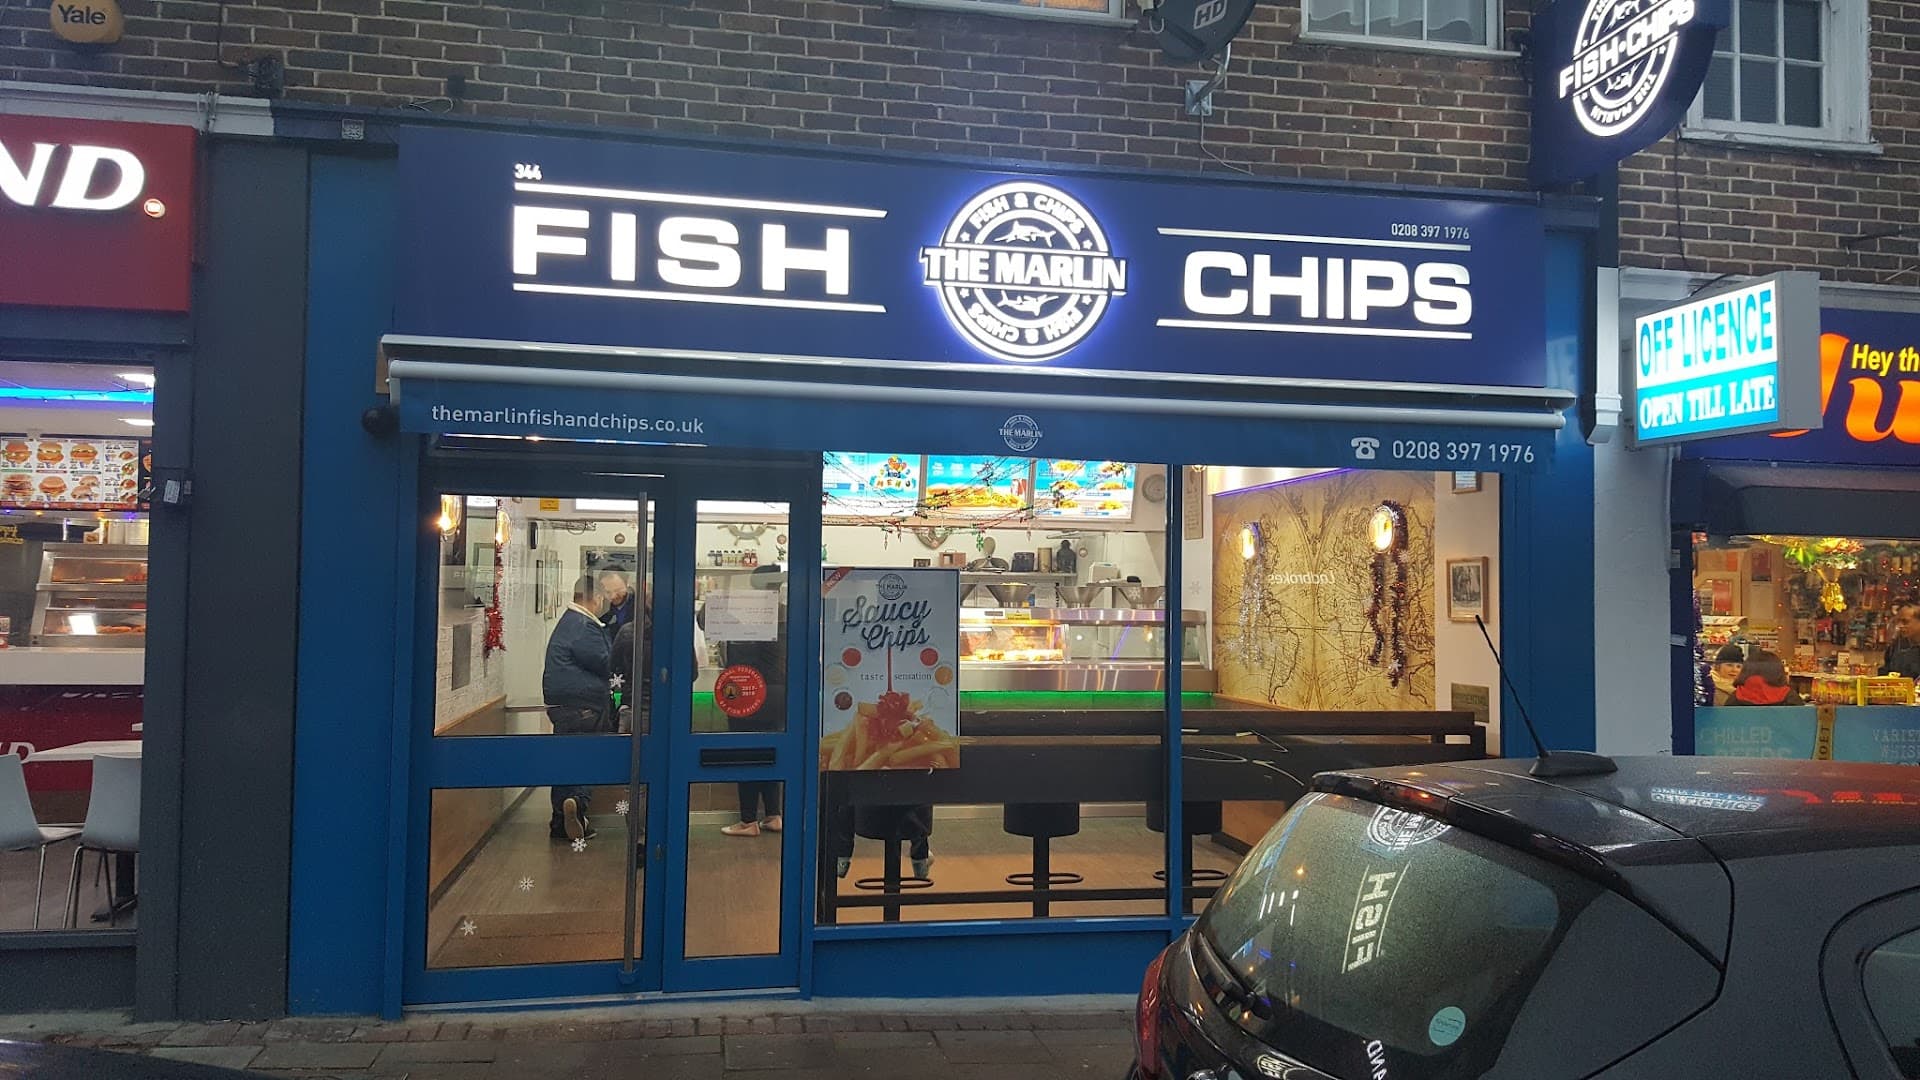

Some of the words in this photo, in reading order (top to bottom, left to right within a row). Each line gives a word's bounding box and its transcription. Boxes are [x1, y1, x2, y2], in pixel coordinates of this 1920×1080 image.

[58, 4, 106, 25] Yale
[515, 163, 542, 180] 344
[968, 194, 1011, 230] FISH
[1033, 194, 1085, 235] CHIPS
[1391, 223, 1418, 237] 0208
[1420, 224, 1441, 238] 397
[1443, 226, 1470, 240] 1976
[513, 205, 849, 296] FISH
[925, 247, 990, 283] THE
[995, 251, 1127, 290] MARLIN
[1183, 250, 1473, 326] CHIPS
[1640, 316, 1674, 377] OFF
[1681, 288, 1773, 369] LICENCE
[1851, 343, 1894, 377] Hey
[431, 405, 704, 433] themarlinfishandchips.co.uk
[1639, 391, 1685, 430] OPEN
[1686, 385, 1726, 423] TILL
[1729, 375, 1776, 416] LATE
[1392, 440, 1440, 460] 0208
[1446, 442, 1481, 461] 397
[1488, 444, 1535, 463] 1976
[842, 595, 932, 634] Saucy
[861, 624, 930, 652] Chips
[861, 672, 884, 681] taste
[894, 671, 932, 681] sensation
